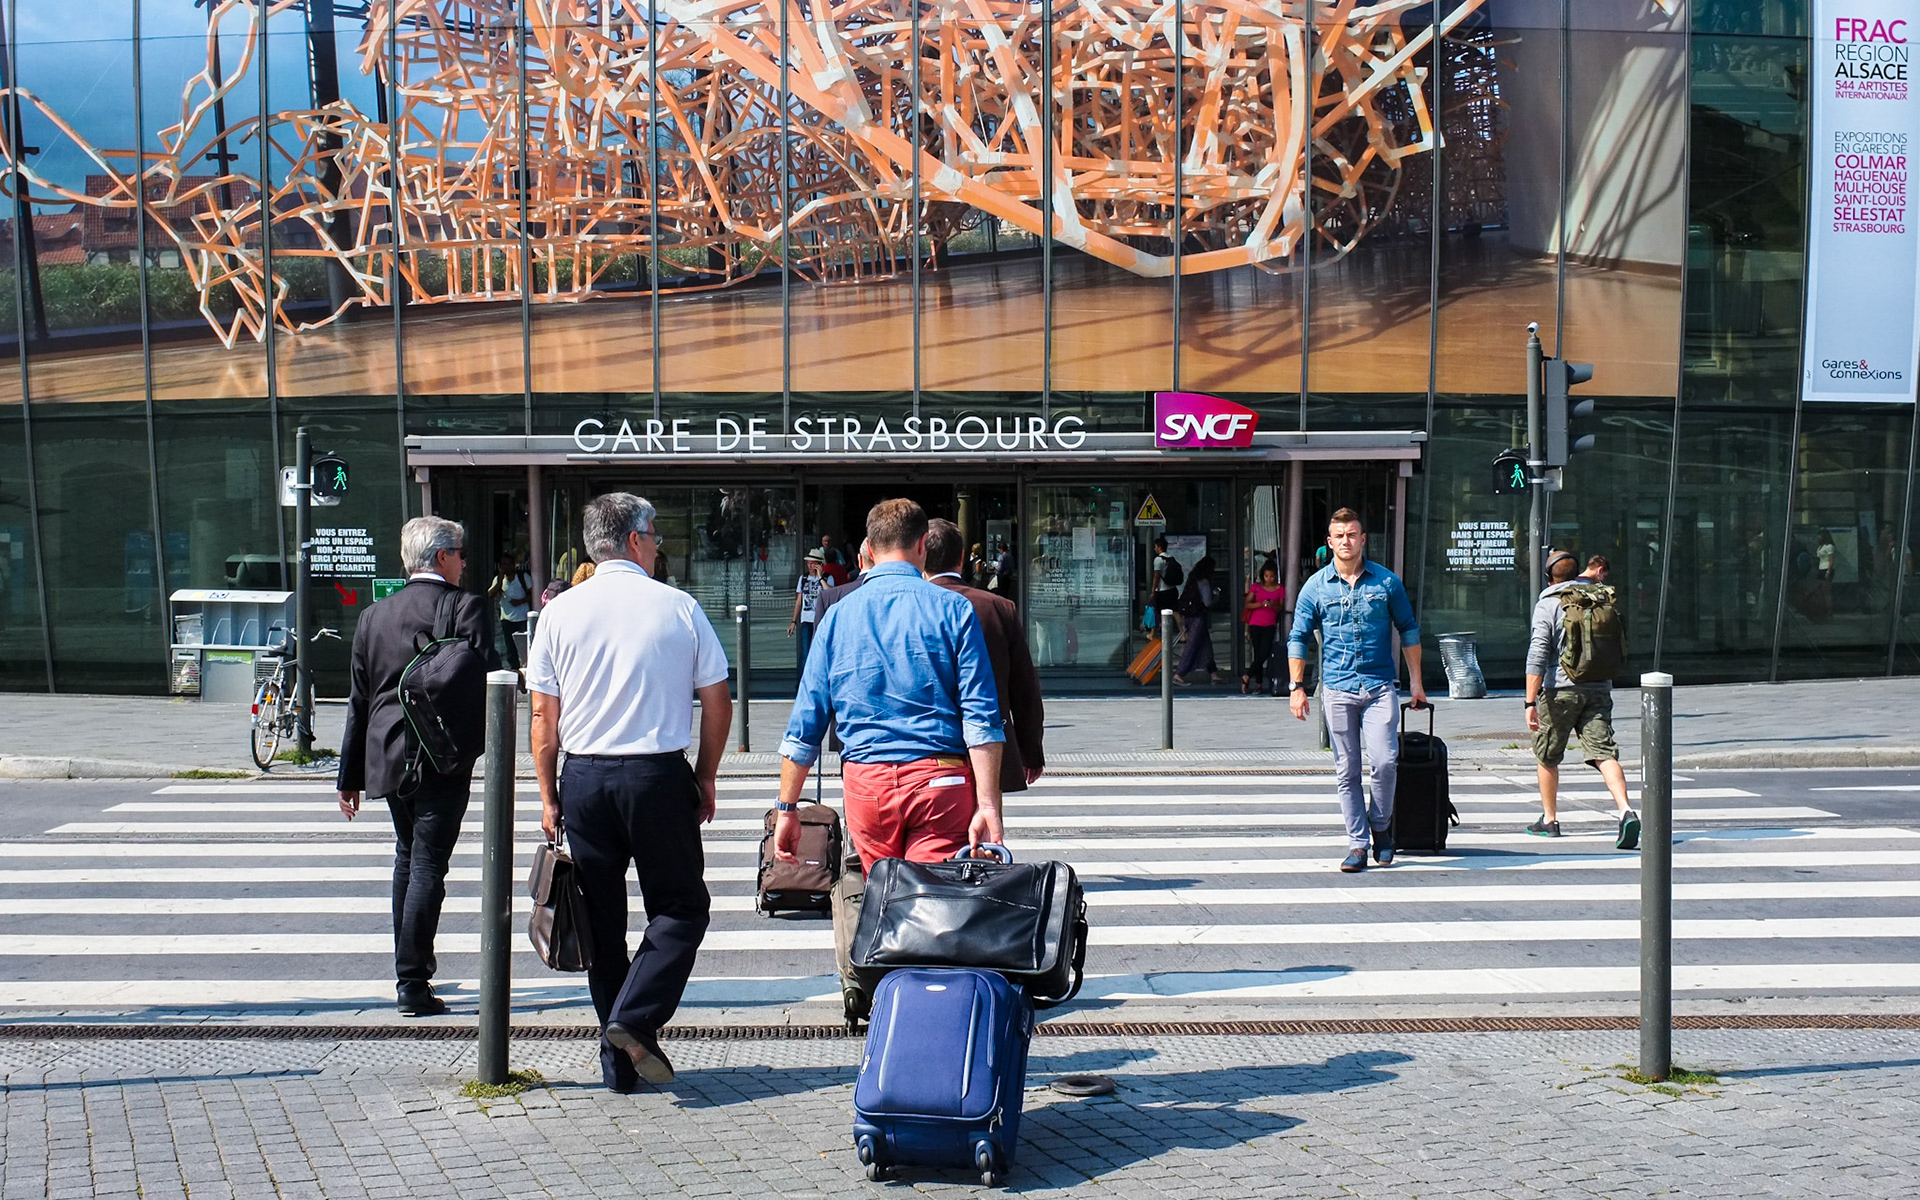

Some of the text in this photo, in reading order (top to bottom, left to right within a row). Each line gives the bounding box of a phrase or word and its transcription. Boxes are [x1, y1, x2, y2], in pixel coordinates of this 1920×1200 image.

[1836, 17, 1908, 44] FRAC
[1835, 40, 1909, 62] RÉGION
[1835, 62, 1908, 80] ALSACE
[1835, 80, 1908, 92] 544 ARTISTES
[1835, 91, 1908, 100] INTERNATIONAUX
[1834, 131, 1908, 143] EXPOSITIONS
[1834, 143, 1907, 154] EN GARES DE
[1835, 154, 1907, 170] COLMAR
[1834, 170, 1907, 182] HAGUENAU
[1834, 181, 1906, 194] MULHOUSE
[1834, 194, 1906, 206] SAINT-LOUIS
[1834, 204, 1906, 222] SÉLESTAT
[1833, 222, 1905, 234] STRASBOURG
[1160, 413, 1253, 440] SNCF
[573, 416, 1086, 452] GARE DE STRASBOURG
[315, 528, 367, 536] VOUS ENTREZ
[1458, 522, 1509, 530] VOUS ENTREZ
[1450, 531, 1472, 539] DANS
[1473, 531, 1484, 539] UN
[332, 538, 343, 546] UN
[344, 538, 374, 546] ESPACE
[1457, 539, 1508, 548] NON-FUMEUR
[316, 546, 367, 554] NON-FUMEUR
[1446, 548, 1471, 556] MERCI
[1449, 556, 1515, 565] VOTRE CIGARETTE
[335, 564, 376, 572] CIGARETTE
